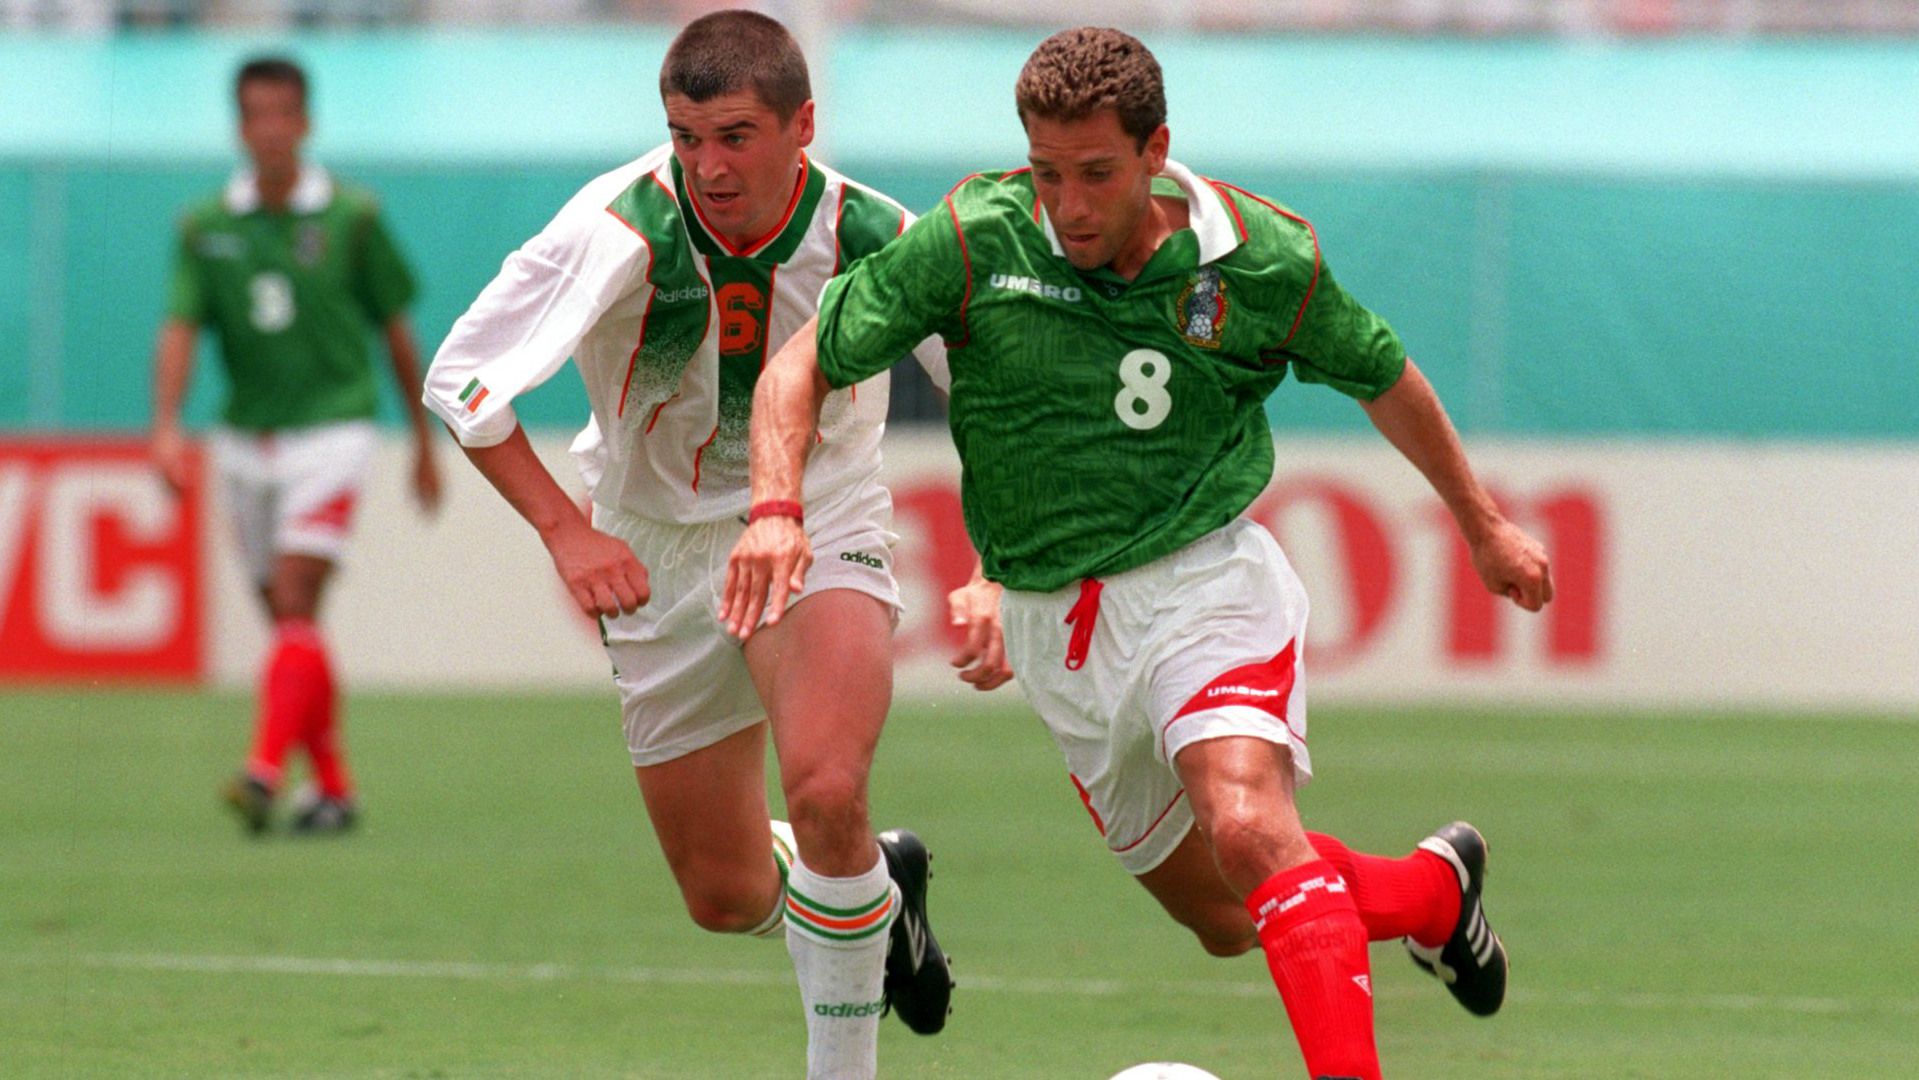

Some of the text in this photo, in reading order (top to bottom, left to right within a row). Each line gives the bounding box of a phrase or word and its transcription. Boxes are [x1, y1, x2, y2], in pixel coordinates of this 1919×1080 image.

[654, 286, 709, 303] adidas
[989, 272, 1082, 303] UMBRO
[715, 282, 765, 356] 6
[1113, 348, 1173, 431] 8
[839, 551, 884, 569] adidas
